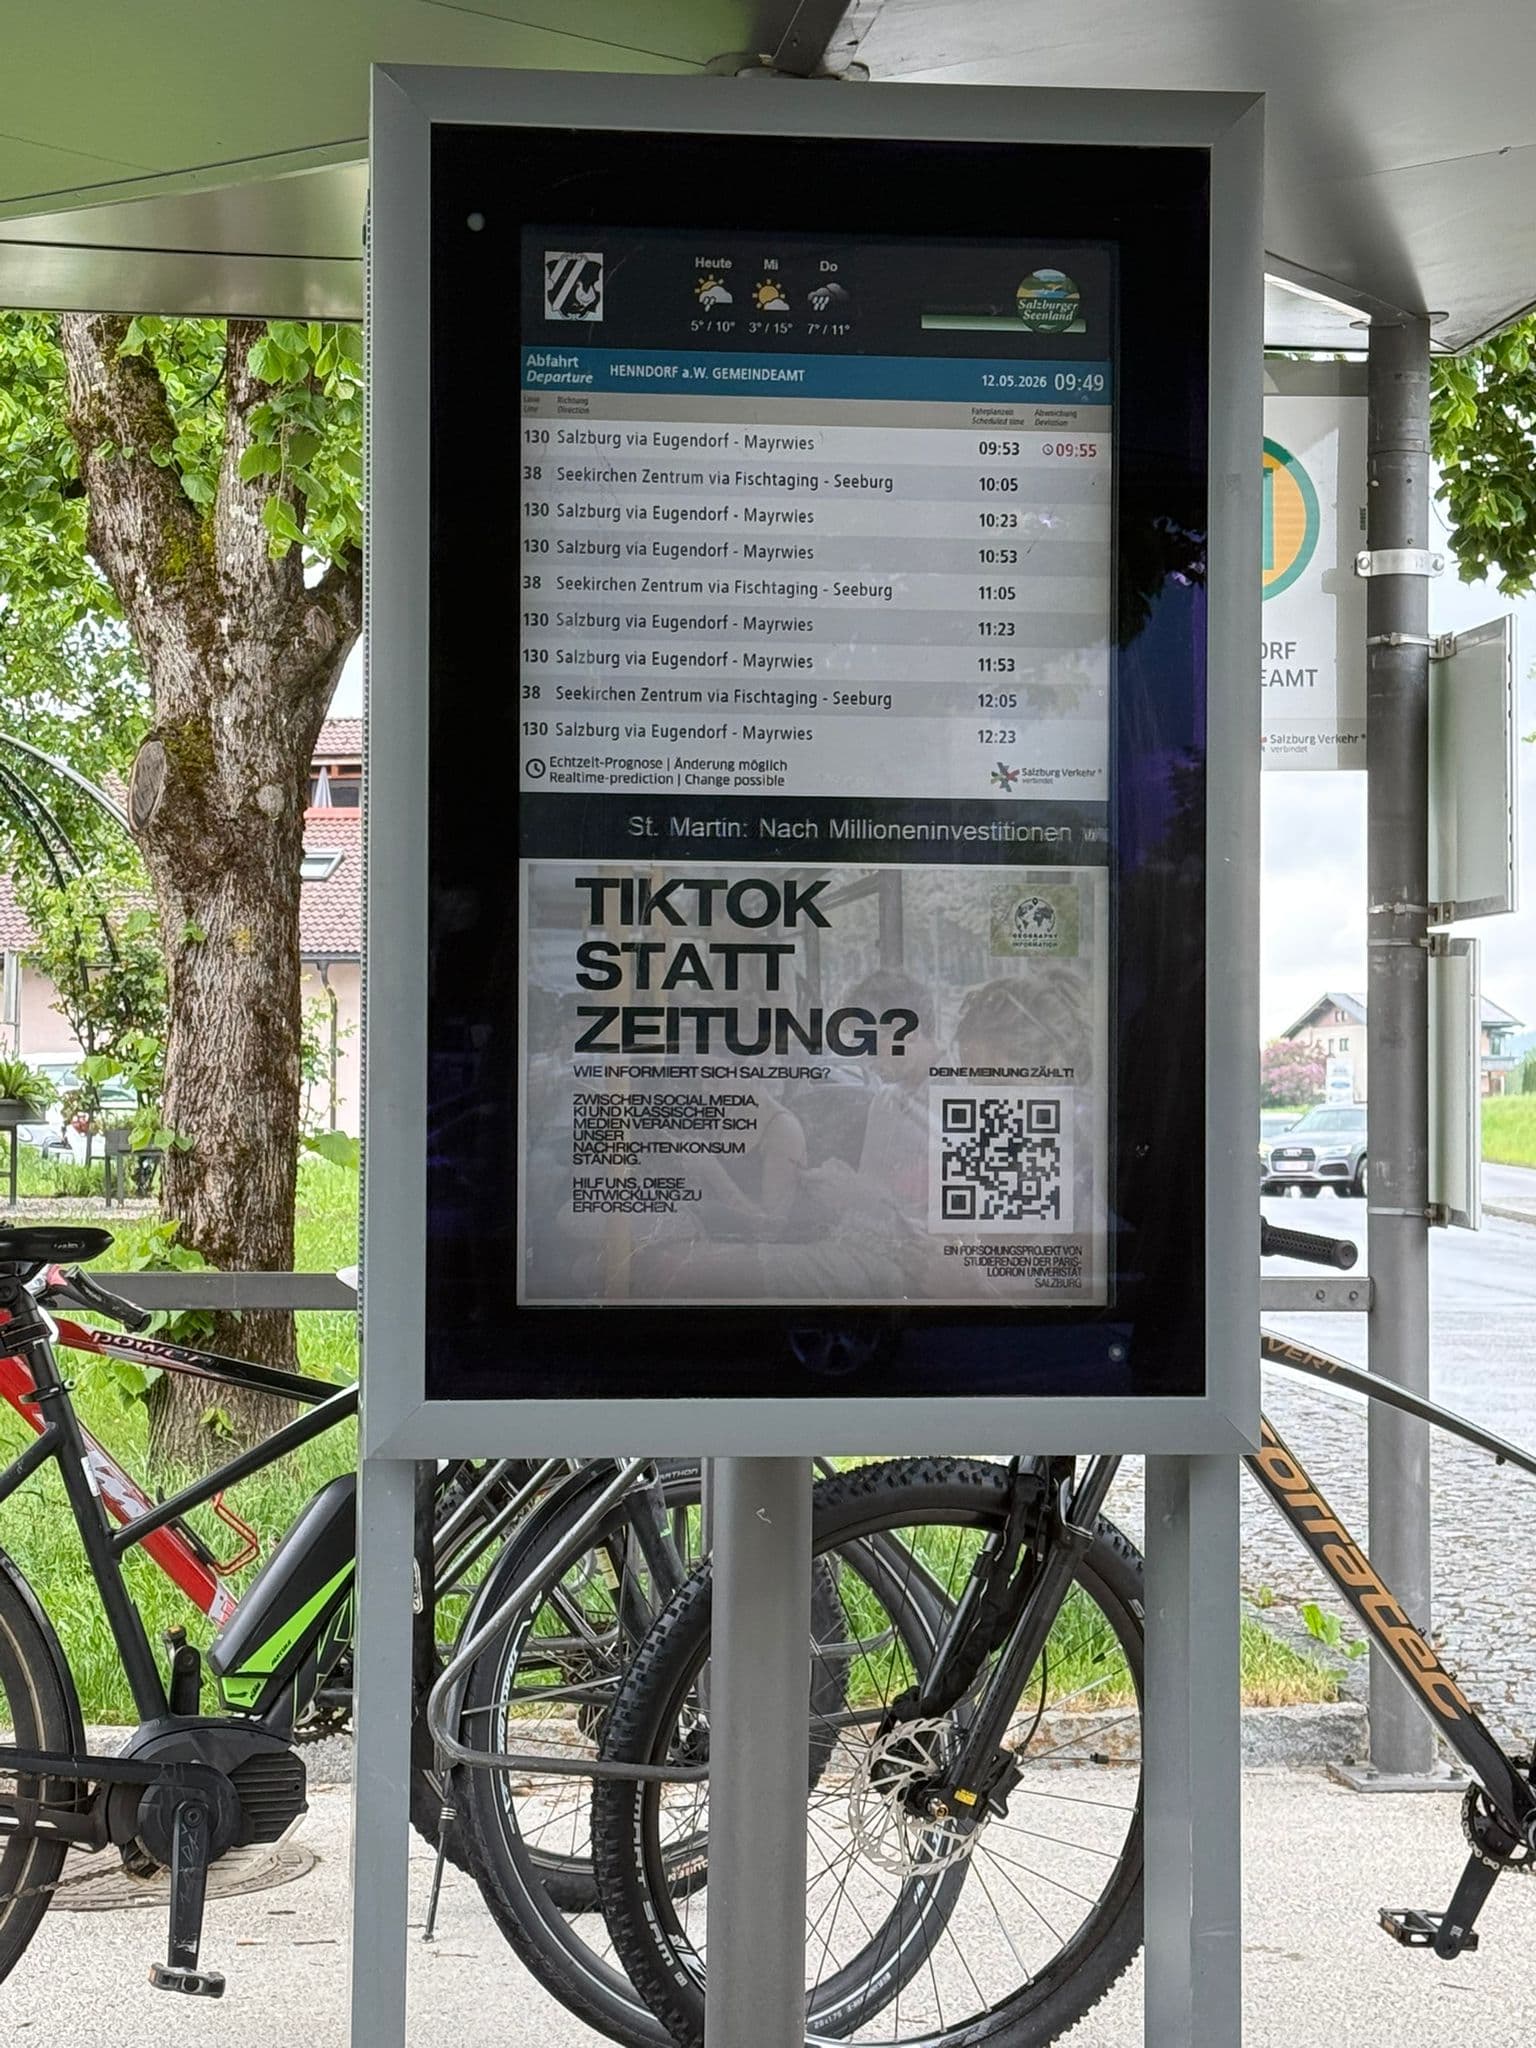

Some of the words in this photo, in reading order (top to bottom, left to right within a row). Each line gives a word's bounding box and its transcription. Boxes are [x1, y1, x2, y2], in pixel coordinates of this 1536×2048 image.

[694, 256, 732, 270] Heute
[763, 259, 779, 270] Mi
[819, 260, 838, 272] Do
[1017, 298, 1079, 313] Salzburger
[1022, 310, 1074, 322] Seenland
[690, 320, 704, 332] 5°
[716, 321, 736, 332] 10°
[748, 322, 762, 334] 3°
[774, 323, 794, 334] 15°
[808, 324, 821, 335] 7°
[832, 324, 850, 336] 11°
[526, 354, 580, 368] Abfahrt
[526, 370, 594, 384] Departure
[610, 364, 678, 378] HENNDORF
[682, 366, 708, 380] a.W.
[712, 368, 806, 382] GEMEINDEAMT
[981, 375, 1048, 388] 12.05.2026
[1054, 374, 1105, 392] 09:49
[524, 430, 550, 444] 130
[556, 430, 622, 448] Salzburg
[626, 432, 648, 446] via
[652, 432, 730, 450] Eugendorf
[744, 435, 814, 453] Mayrwies
[978, 442, 1020, 456] 09:53
[1056, 444, 1097, 458] 09:55
[522, 466, 542, 480] 38
[556, 466, 638, 484] Seekirchen
[642, 468, 704, 484] Zentrum
[708, 470, 730, 485] via
[735, 471, 820, 490] Fischtaging
[834, 474, 894, 492] Seeburg
[978, 478, 1018, 492] 10:05
[524, 503, 550, 517] 130
[556, 503, 621, 521] Salzburg
[626, 505, 648, 519] via
[652, 505, 729, 523] Eugendorf
[744, 508, 814, 526] Mayrwies
[978, 514, 1018, 528] 10:23
[524, 539, 550, 554] 130
[556, 539, 621, 558] Salzburg
[626, 542, 648, 556] via
[652, 541, 729, 560] Eugendorf
[744, 545, 814, 563] Mayrwies
[978, 550, 1018, 564] 10:53
[522, 576, 542, 589] 38
[556, 576, 637, 592] Seekirchen
[641, 578, 704, 593] Zentrum
[708, 580, 730, 594] via
[734, 580, 819, 600] Fischtaging
[833, 582, 893, 602] Seeburg
[978, 586, 1016, 600] 11:05
[523, 612, 550, 627] 130
[556, 612, 621, 631] Salzburg
[625, 615, 647, 629] via
[652, 614, 729, 633] Eugendorf
[743, 618, 814, 636] Mayrwies
[978, 622, 1016, 636] 11:23
[523, 649, 550, 664] 130
[556, 649, 620, 668] Salzburg
[625, 652, 647, 666] via
[652, 651, 728, 670] Eugendorf
[743, 654, 814, 672] Mayrwies
[978, 658, 1016, 672] 11:53
[521, 686, 541, 699] 38
[555, 686, 636, 702] Seekirchen
[640, 688, 703, 703] Zentrum
[707, 690, 729, 704] via
[734, 690, 818, 710] Fischtaging
[832, 692, 892, 712] Seeburg
[978, 694, 1017, 708] 12:05
[522, 722, 549, 736] 130
[555, 722, 620, 740] Salzburg
[624, 724, 646, 738] via
[651, 724, 728, 742] Eugendorf
[742, 728, 813, 746] Mayrwies
[978, 730, 1016, 744] 12:23
[1270, 734, 1316, 746] Salzburg
[1318, 734, 1359, 744] Verkehr
[549, 756, 664, 772] Echtzeit-Prognose
[674, 756, 735, 772] Änderung
[739, 758, 788, 774] möglich
[1022, 768, 1060, 778] Salzburg
[1062, 768, 1096, 778] Verkehr
[549, 772, 674, 786] Realtime-prediction
[684, 774, 730, 789] Change
[734, 774, 786, 789] possible
[628, 816, 658, 836] St.
[670, 817, 748, 838] Martin:
[760, 818, 818, 839] Nach
[830, 818, 1072, 842] Millioneninvestitionen
[574, 878, 833, 928] TIKTOK
[576, 942, 796, 992] STATT
[574, 1007, 920, 1058] ZEITUNG?
[574, 1066, 602, 1078] WIE
[604, 1066, 700, 1078] INFORMIERT
[700, 1066, 738, 1078] SICH
[740, 1067, 831, 1080] SALZBURG?
[929, 1066, 968, 1077] DEINE
[968, 1067, 1030, 1078] MEINUNG
[1030, 1066, 1074, 1078] ZÄHLT!
[573, 1094, 652, 1106] ZWISCHEN
[654, 1094, 708, 1106] SOCIAL
[709, 1095, 759, 1108] MEDIA,
[574, 1106, 588, 1117] KI
[588, 1106, 622, 1118] UND
[624, 1106, 725, 1118] KLASSISCHEN
[574, 1118, 632, 1130] MEDIEN
[722, 1118, 757, 1130] SICH
[573, 1130, 624, 1142] UNSER
[573, 1142, 746, 1154] NACHRICHTENKONSUM
[573, 1177, 604, 1189] HILF
[605, 1178, 641, 1191] UNS,
[643, 1178, 686, 1189] DIESE
[573, 1190, 680, 1201] ENTWICKLUNG
[681, 1190, 702, 1201] ZU
[573, 1201, 677, 1213] ERFORSCHEN.
[944, 1246, 958, 1256] EIN
[960, 1246, 1061, 1256] FORSCHUNGSPROJEKT
[1062, 1246, 1082, 1256] VON
[964, 1256, 1032, 1266] STUDIERENDEN
[1032, 1257, 1051, 1266] DER
[986, 1267, 1026, 1278] LODRON
[1034, 1278, 1082, 1288] SALZBURG
[1268, 1337, 1338, 1374] VERT
[643, 1900, 675, 1968] SAM
